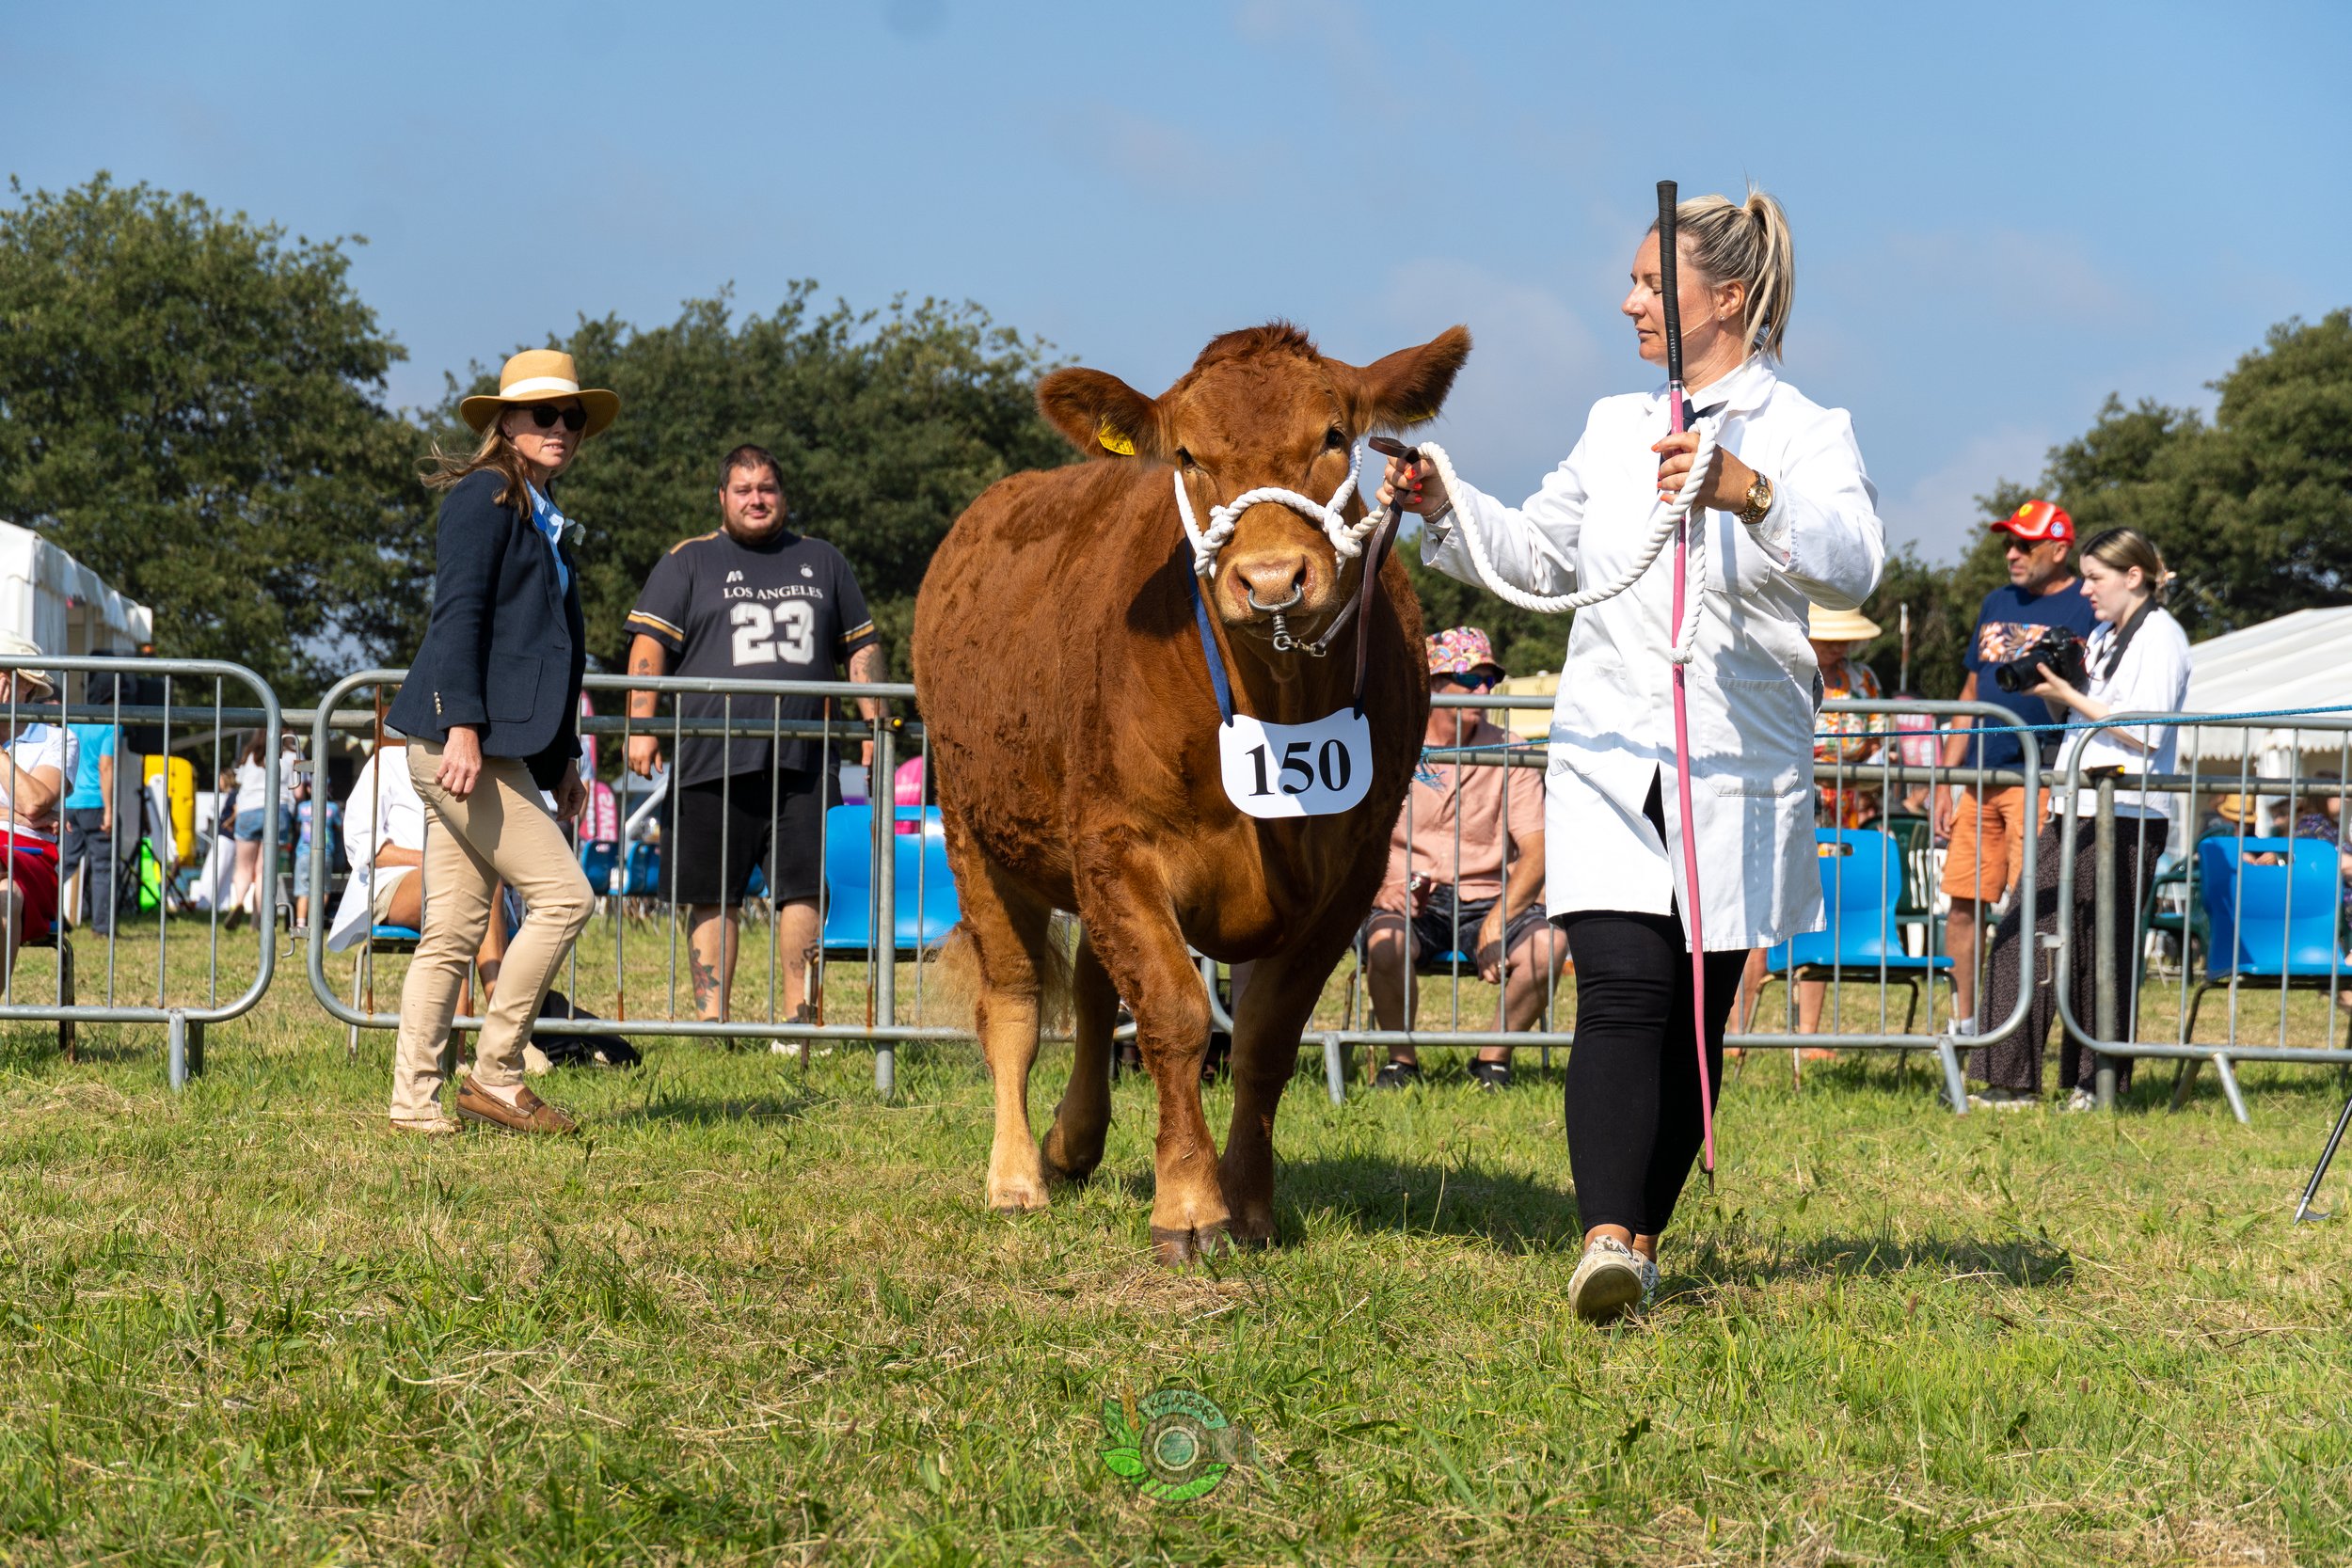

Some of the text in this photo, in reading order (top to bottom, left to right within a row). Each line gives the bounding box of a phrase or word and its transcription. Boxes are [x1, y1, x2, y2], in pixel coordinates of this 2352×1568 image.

[723, 585, 824, 600] LOS ANGELES
[730, 599, 815, 667] 23
[1245, 738, 1351, 797] 150
